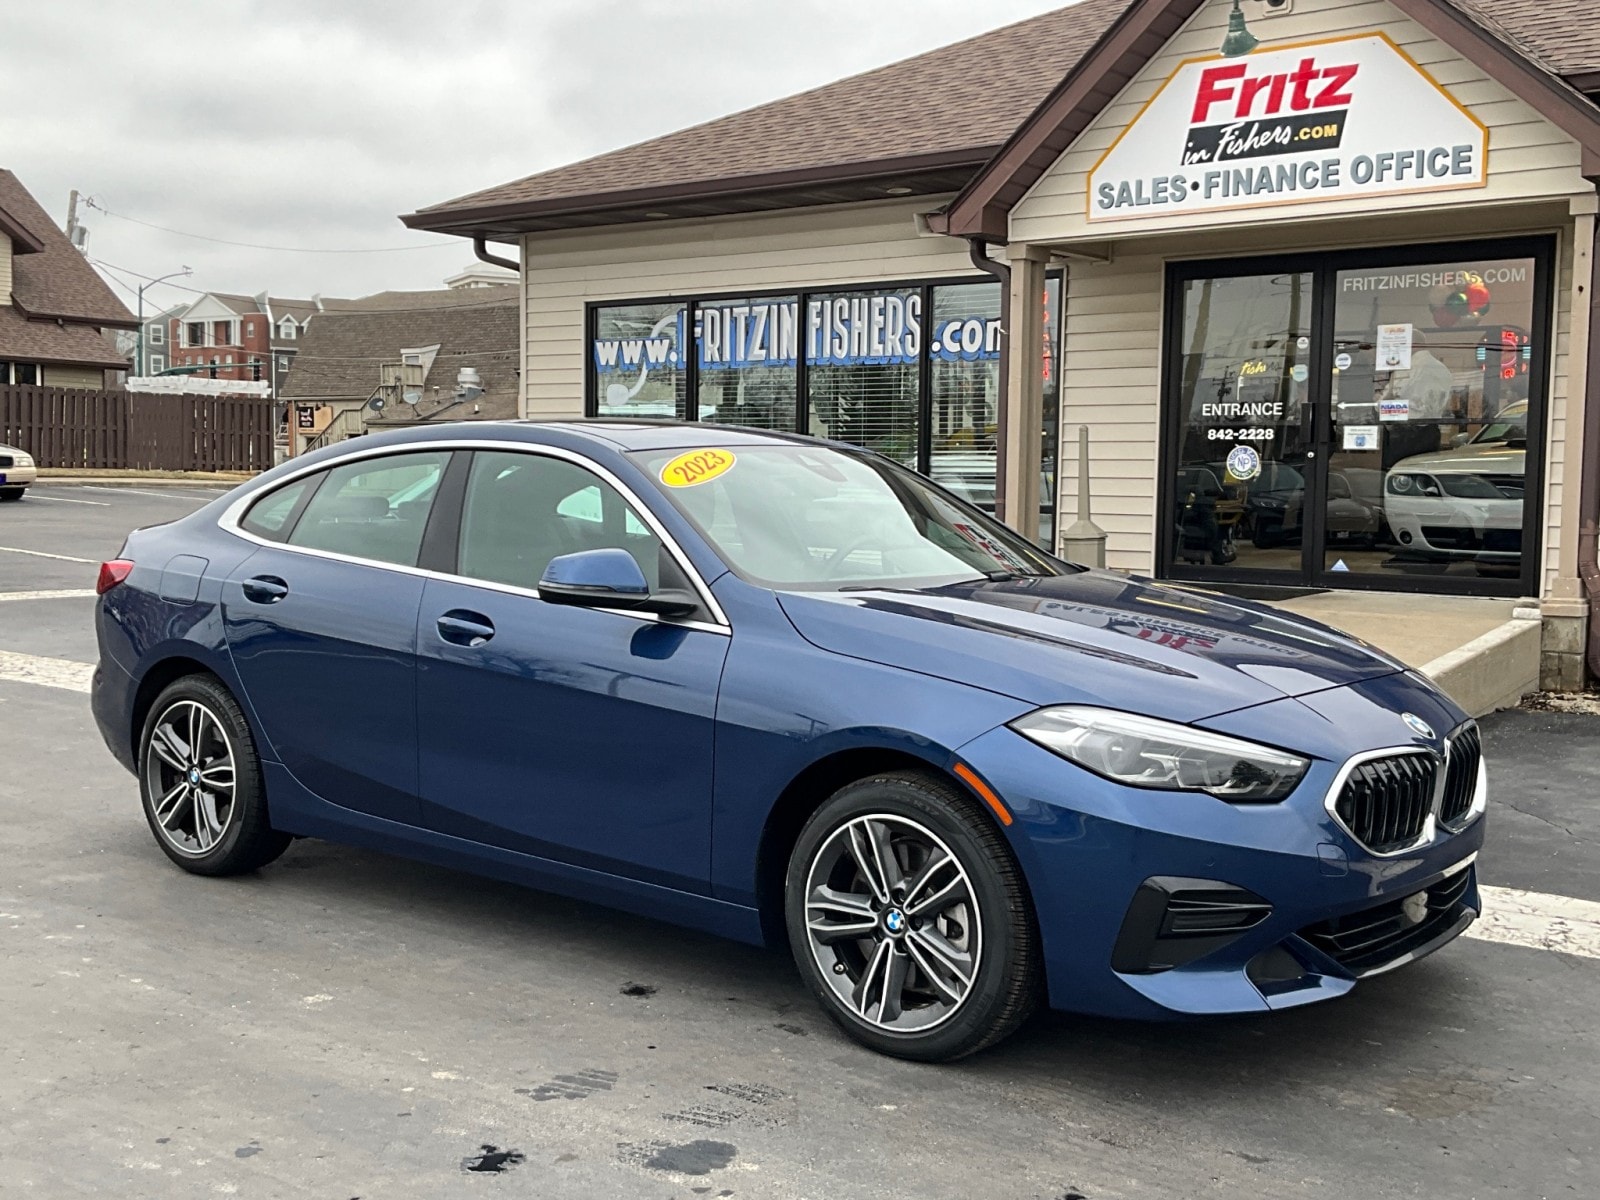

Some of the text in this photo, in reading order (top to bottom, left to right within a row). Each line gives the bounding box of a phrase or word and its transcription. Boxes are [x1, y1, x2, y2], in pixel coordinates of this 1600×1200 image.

[1191, 57, 1359, 123] Fritz
[1184, 142, 1211, 164] in
[1350, 144, 1472, 185] OFFICE
[1202, 402, 1283, 416] ENTRANCE
[1208, 428, 1274, 440] 842-2228
[673, 451, 726, 482] 2023
